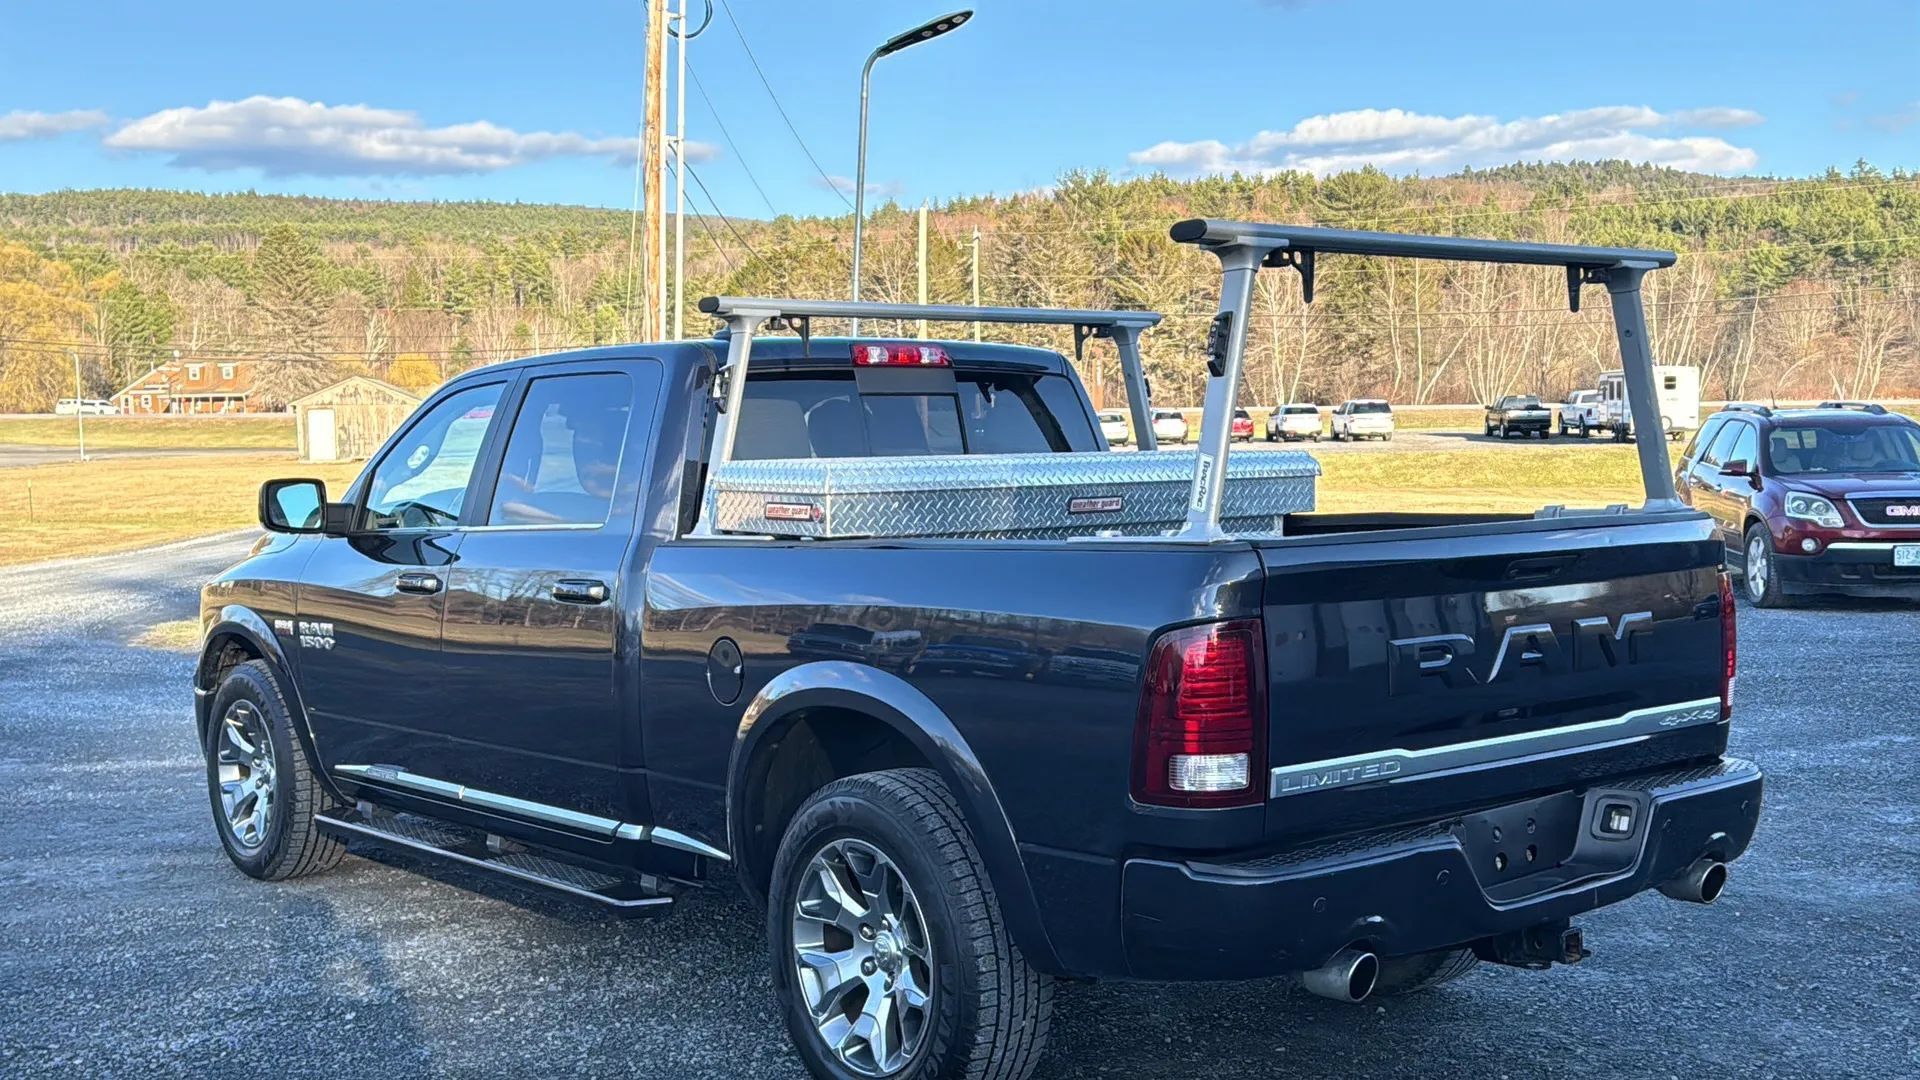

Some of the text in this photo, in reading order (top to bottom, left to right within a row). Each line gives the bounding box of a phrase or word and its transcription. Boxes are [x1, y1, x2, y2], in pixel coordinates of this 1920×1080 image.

[767, 506, 809, 516] weather guard
[1072, 499, 1120, 509] weather guard
[299, 621, 334, 636] RAM
[299, 635, 336, 650] 1500
[1387, 611, 1653, 697] RAM
[1280, 760, 1401, 792] LIMITED
